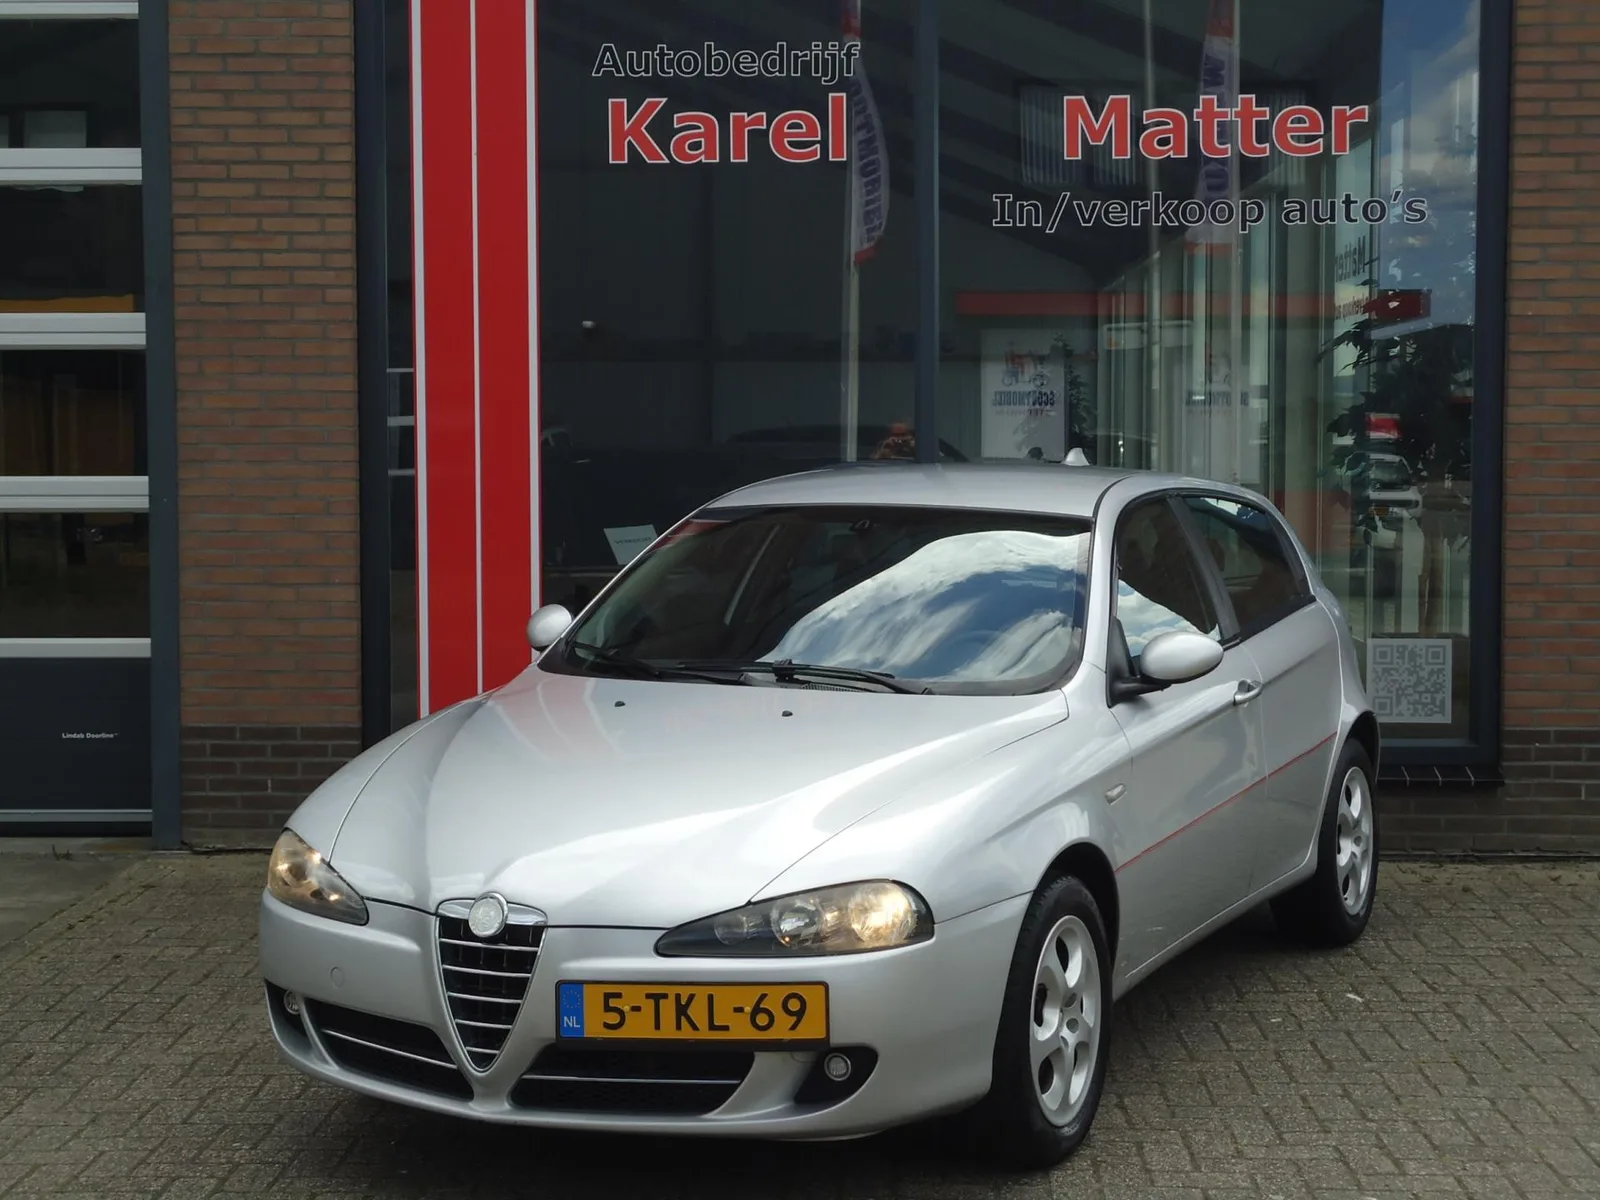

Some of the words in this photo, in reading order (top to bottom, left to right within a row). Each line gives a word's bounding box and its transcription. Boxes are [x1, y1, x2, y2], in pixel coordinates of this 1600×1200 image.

[592, 41, 861, 85] Autobedrijf
[608, 93, 847, 163] Karel
[1063, 94, 1369, 160] Matter
[992, 192, 1266, 233] In/verkoop
[1281, 189, 1429, 225] auto's
[563, 1015, 581, 1028] NL
[602, 991, 808, 1032] 5-TKL-69
